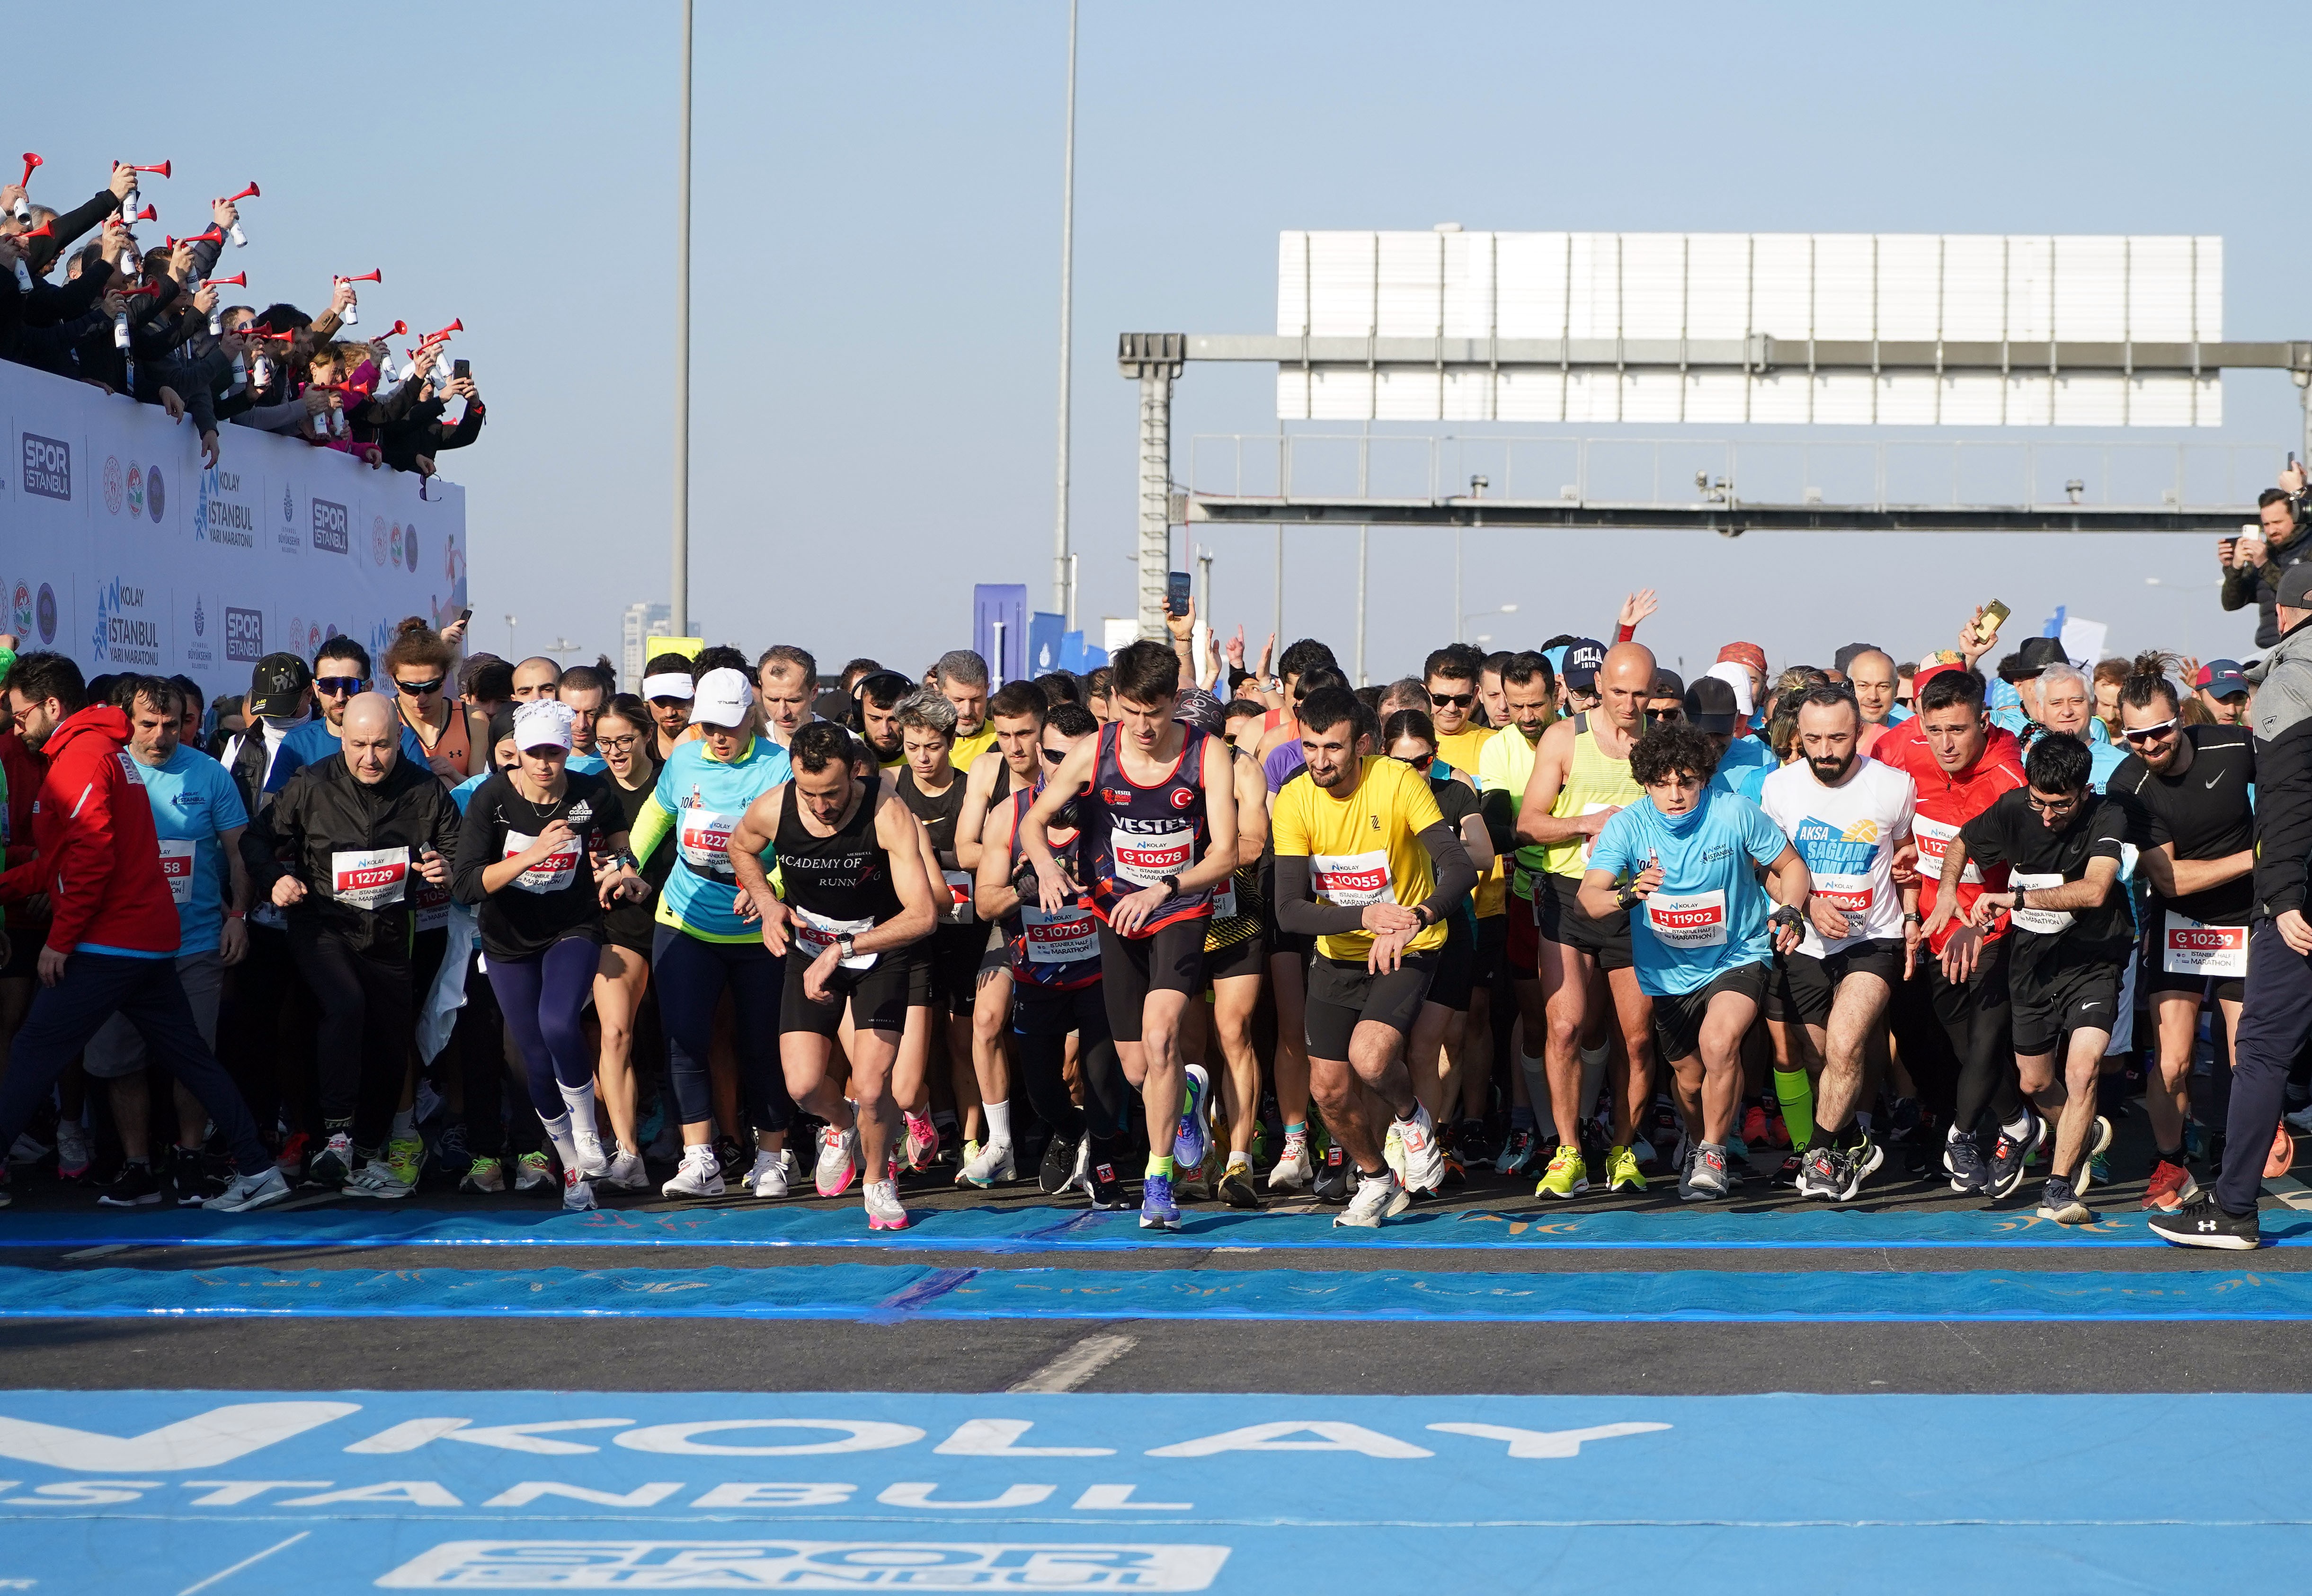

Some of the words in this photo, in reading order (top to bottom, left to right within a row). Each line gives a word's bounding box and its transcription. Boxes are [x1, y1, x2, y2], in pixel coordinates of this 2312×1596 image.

[25, 439, 68, 475] SPOR
[219, 470, 240, 492] KOLAY
[313, 503, 346, 533] SPOR
[209, 528, 221, 543] YARI
[222, 532, 253, 549] MARATONU
[120, 586, 144, 608] KOLAY
[228, 613, 260, 639] SPOR
[109, 647, 124, 662] YARI
[124, 649, 159, 666] MARATONU
[1573, 647, 1603, 665] UCLA
[1110, 812, 1192, 834] VESTEL
[700, 833, 729, 848] 1227
[1799, 826, 1829, 841] AKSA
[1123, 851, 1135, 860] G
[1138, 851, 1182, 864] 10678
[1807, 838, 1871, 862] SAĞLAM
[779, 854, 841, 869] ACADEMY
[844, 857, 862, 869] OF
[356, 870, 393, 884] 12729
[523, 878, 561, 887] MARATHON
[1322, 874, 1334, 884] G
[1335, 875, 1379, 888] 10055
[358, 890, 393, 902] MARATHON
[359, 887, 381, 896] ISTANBUL
[1340, 897, 1380, 906] MARATHON
[1659, 912, 1670, 922] H
[1672, 912, 1713, 924] 11902
[2026, 916, 2060, 925] MARATHON
[806, 929, 817, 939] G
[1033, 927, 1044, 937] G
[1047, 922, 1089, 938] 10703
[2176, 931, 2188, 943] G
[2191, 933, 2234, 946] 10239
[1050, 945, 1089, 955] MARATHON
[342, 1417, 1674, 1459] KOLAY
[463, 1547, 1162, 1569] SPOR
